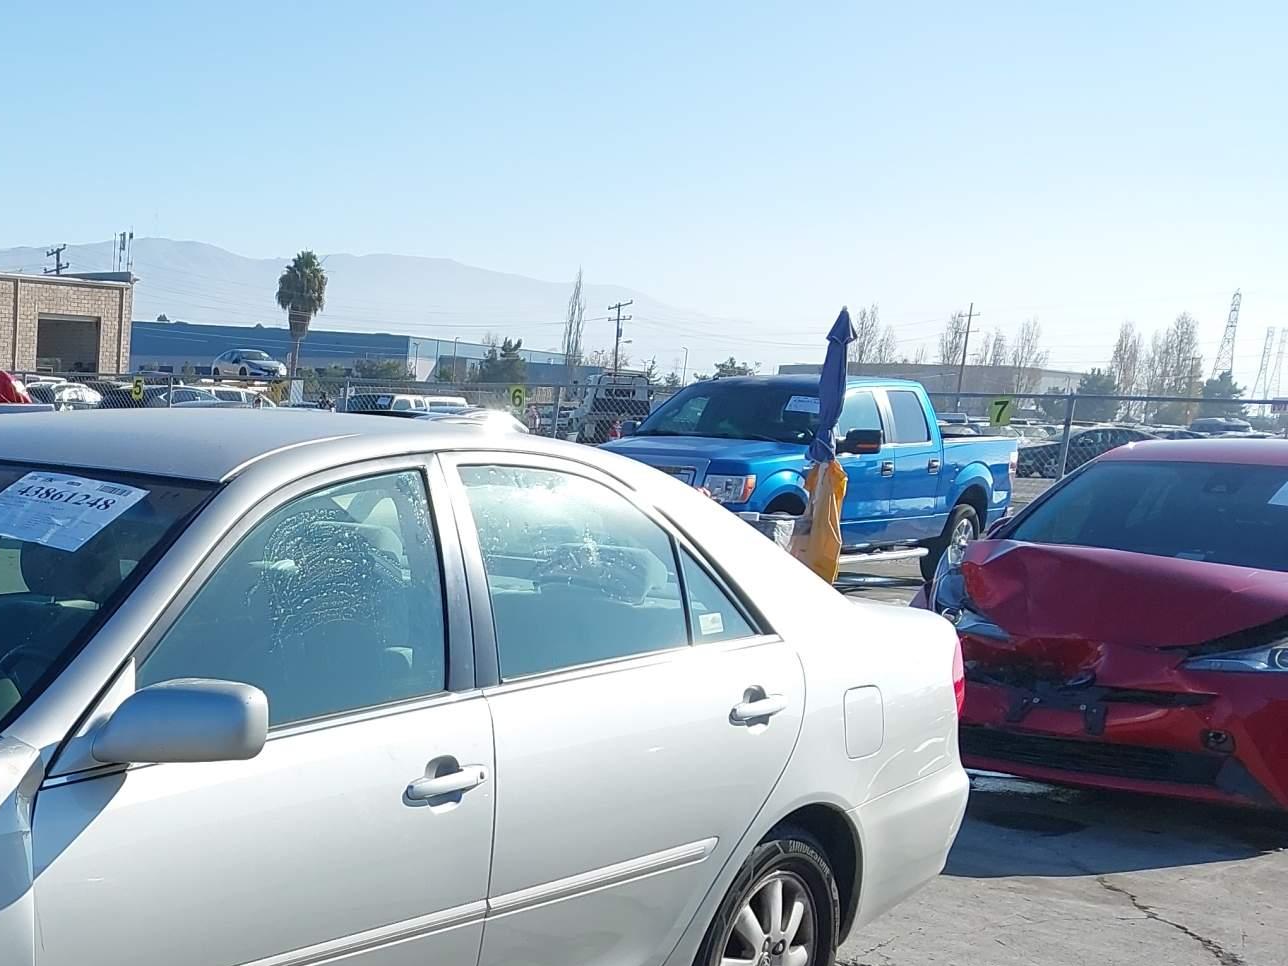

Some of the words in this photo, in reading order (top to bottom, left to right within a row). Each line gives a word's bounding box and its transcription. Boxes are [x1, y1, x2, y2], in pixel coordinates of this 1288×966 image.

[134, 380, 142, 395] 5
[512, 389, 522, 407] 6
[994, 401, 1009, 423] 7
[18, 486, 116, 510] 43861248
